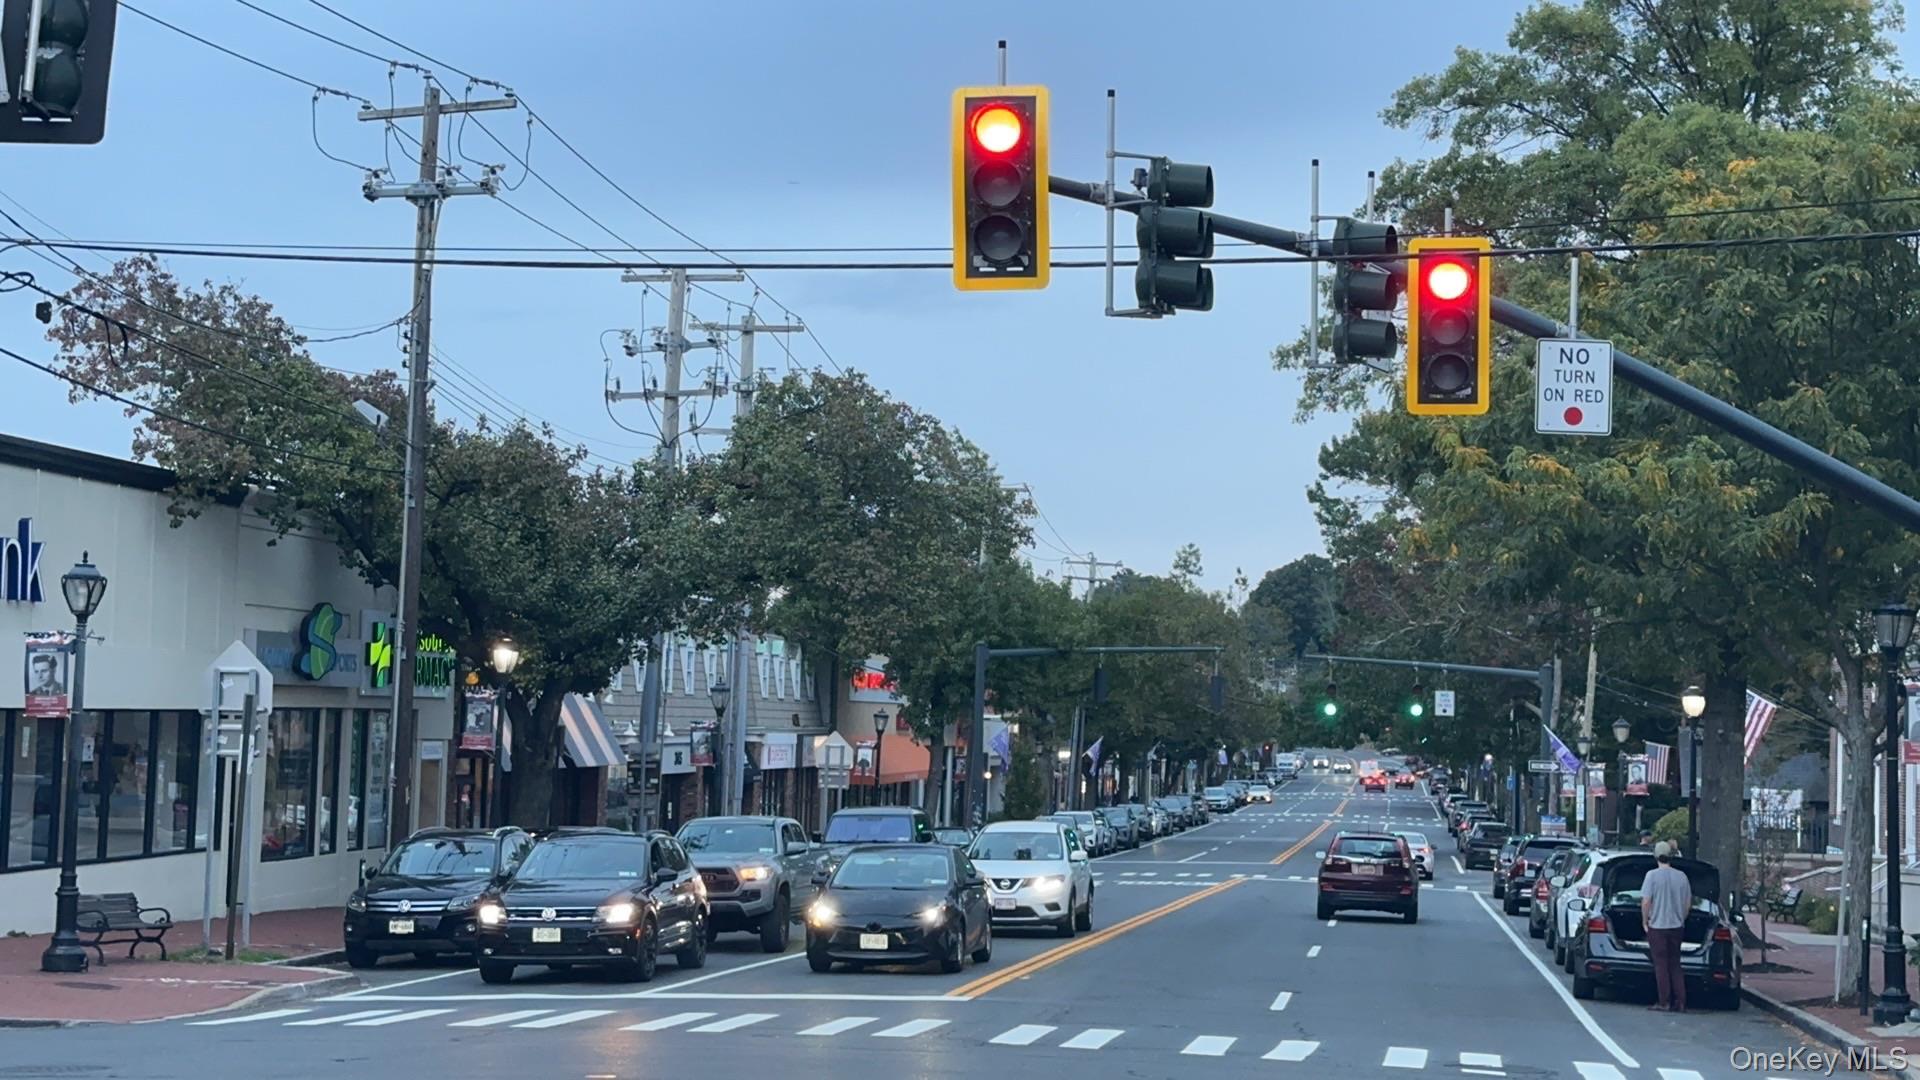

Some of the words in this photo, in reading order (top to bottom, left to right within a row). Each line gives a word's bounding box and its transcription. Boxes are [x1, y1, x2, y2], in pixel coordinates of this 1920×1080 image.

[1559, 347, 1590, 365] NO
[1554, 369, 1595, 384] TURN
[1543, 387, 1565, 402] ON
[1574, 389, 1604, 403] RED
